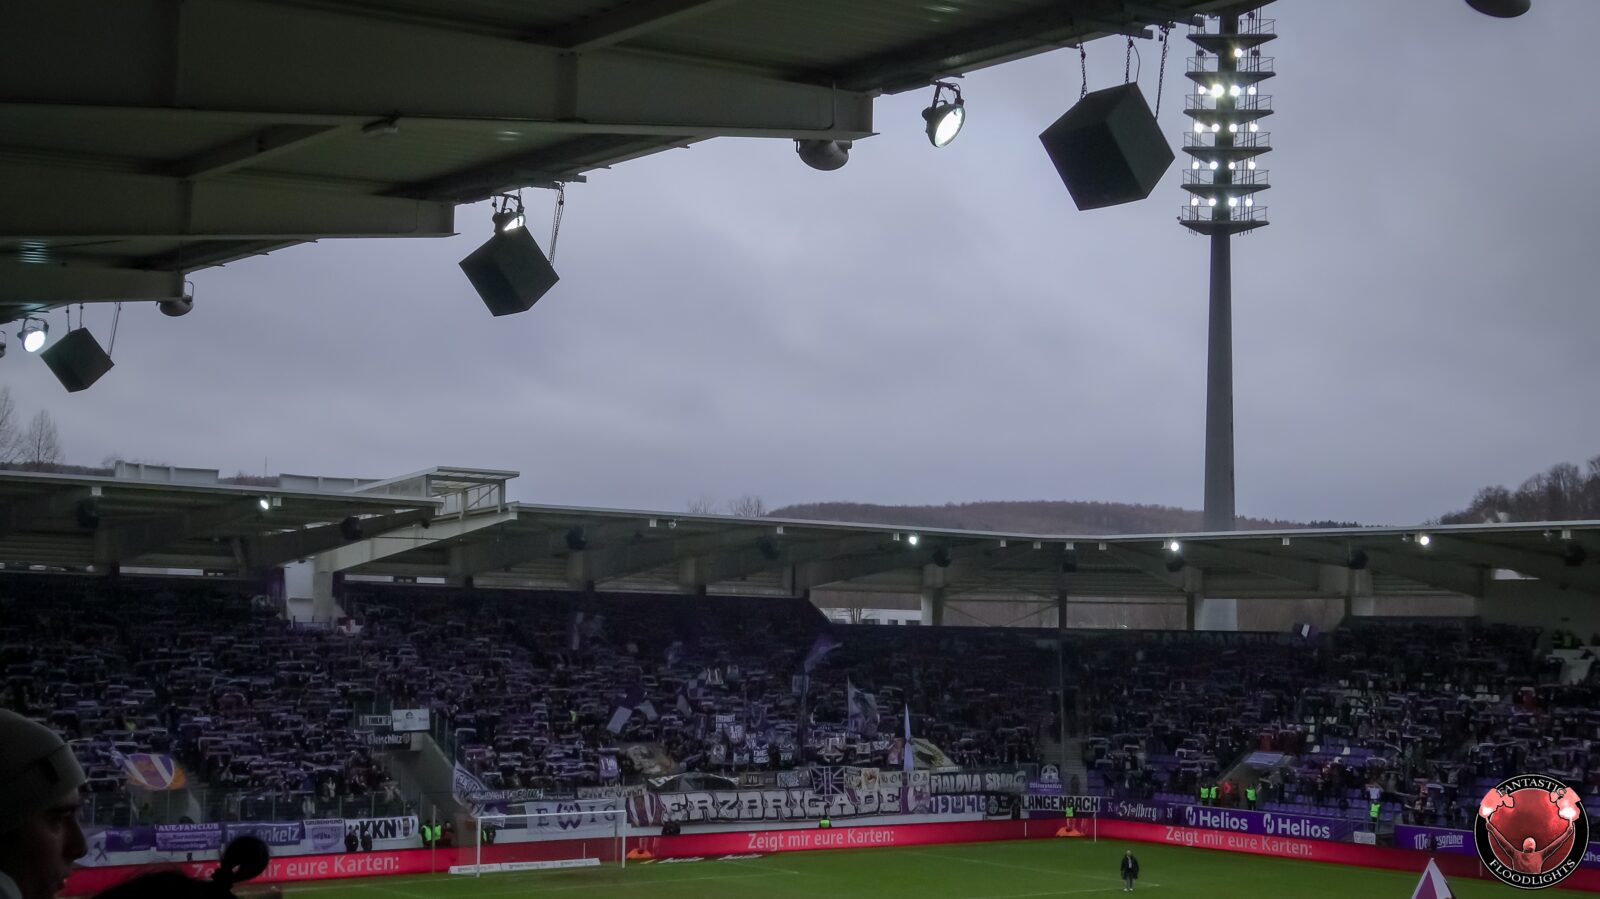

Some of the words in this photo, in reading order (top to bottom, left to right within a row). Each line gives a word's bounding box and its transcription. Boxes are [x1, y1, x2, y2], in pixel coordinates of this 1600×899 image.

[1199, 811, 1248, 831] Helios
[1277, 818, 1330, 839] Helios
[747, 832, 784, 851] Zeigt
[788, 831, 809, 847] mir
[814, 832, 843, 846] eure
[848, 828, 894, 844] Karten:
[1166, 826, 1199, 846] Zeigt
[1203, 830, 1224, 845] mir
[1228, 835, 1257, 849] eure
[1261, 835, 1313, 855] Karten:
[286, 860, 327, 876] eure
[334, 855, 400, 874] Karten:
